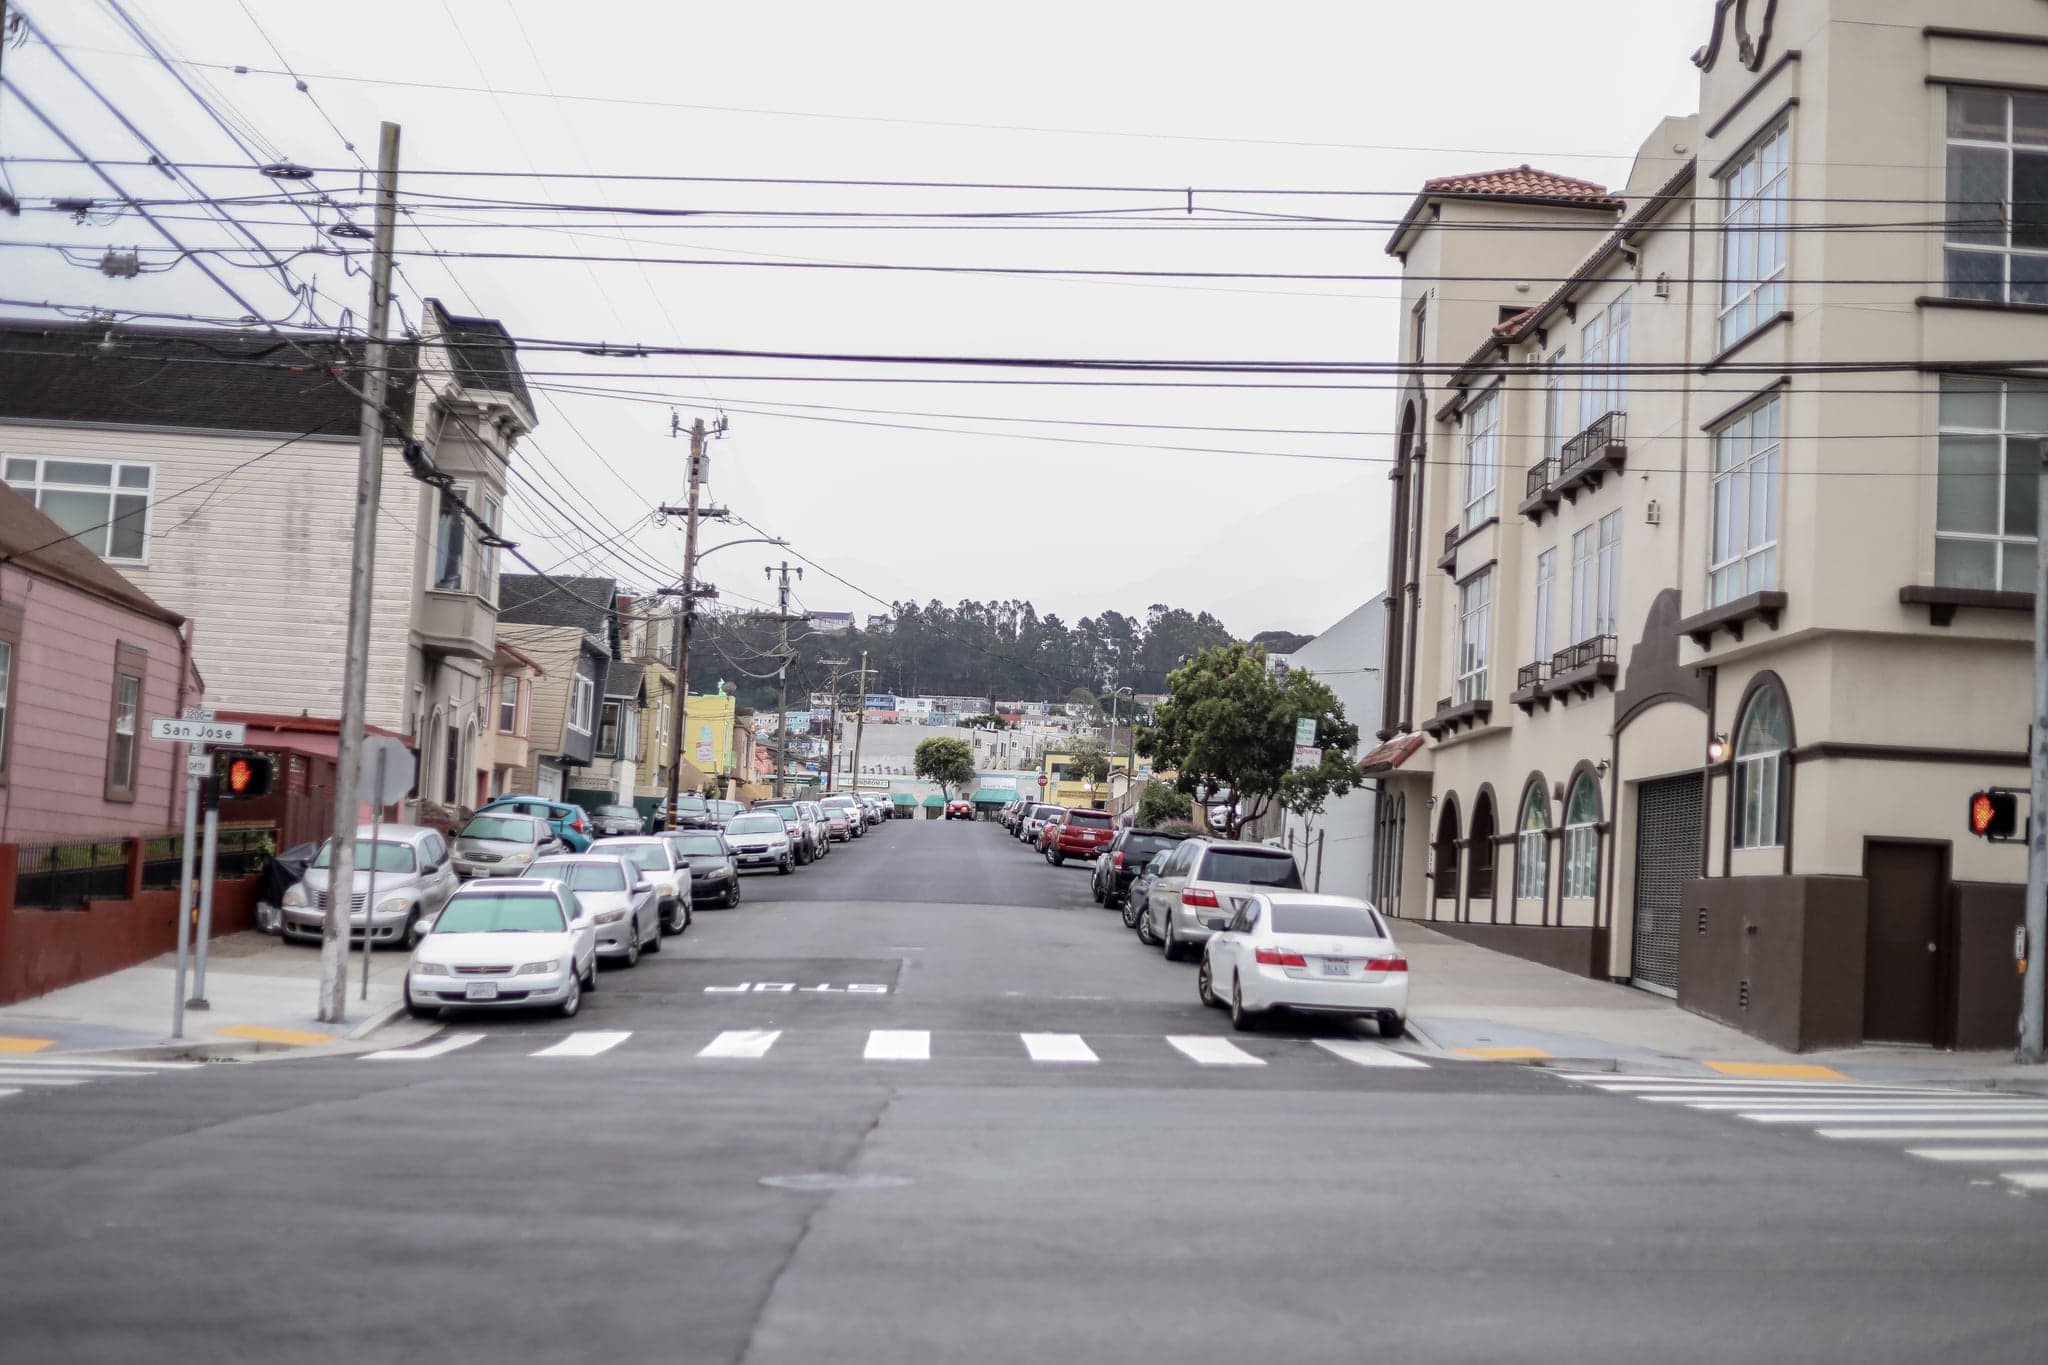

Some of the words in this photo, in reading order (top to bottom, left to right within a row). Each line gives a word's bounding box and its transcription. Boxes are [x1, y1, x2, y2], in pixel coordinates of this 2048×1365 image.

[162, 723, 190, 736] San
[196, 726, 233, 739] Jose
[704, 983, 888, 993] STOP
